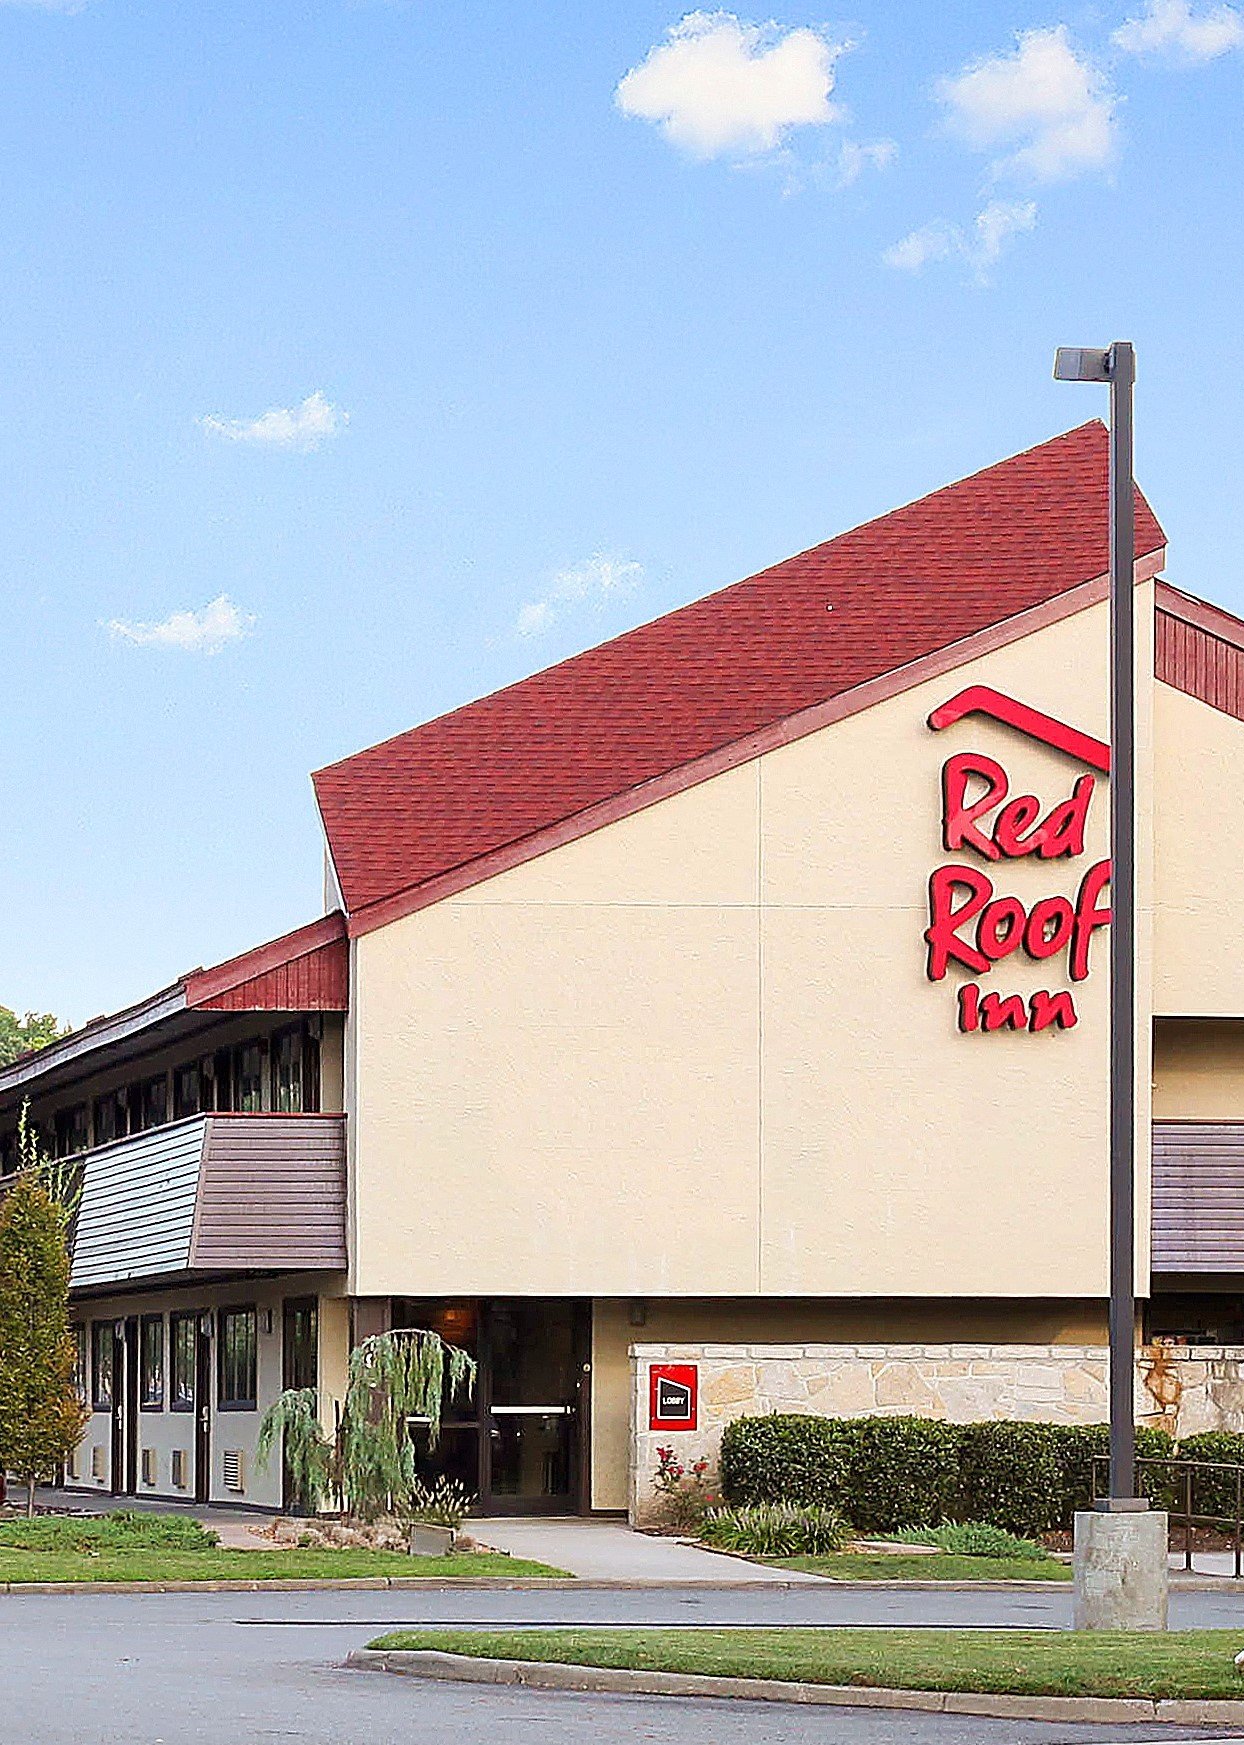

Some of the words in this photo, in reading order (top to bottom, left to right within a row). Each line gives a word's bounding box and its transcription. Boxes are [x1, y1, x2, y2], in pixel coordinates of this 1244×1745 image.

[941, 752, 1096, 860] Red
[925, 858, 1111, 981] Roof
[957, 983, 1078, 1032] Inn
[662, 1396, 685, 1405] LOBBY
